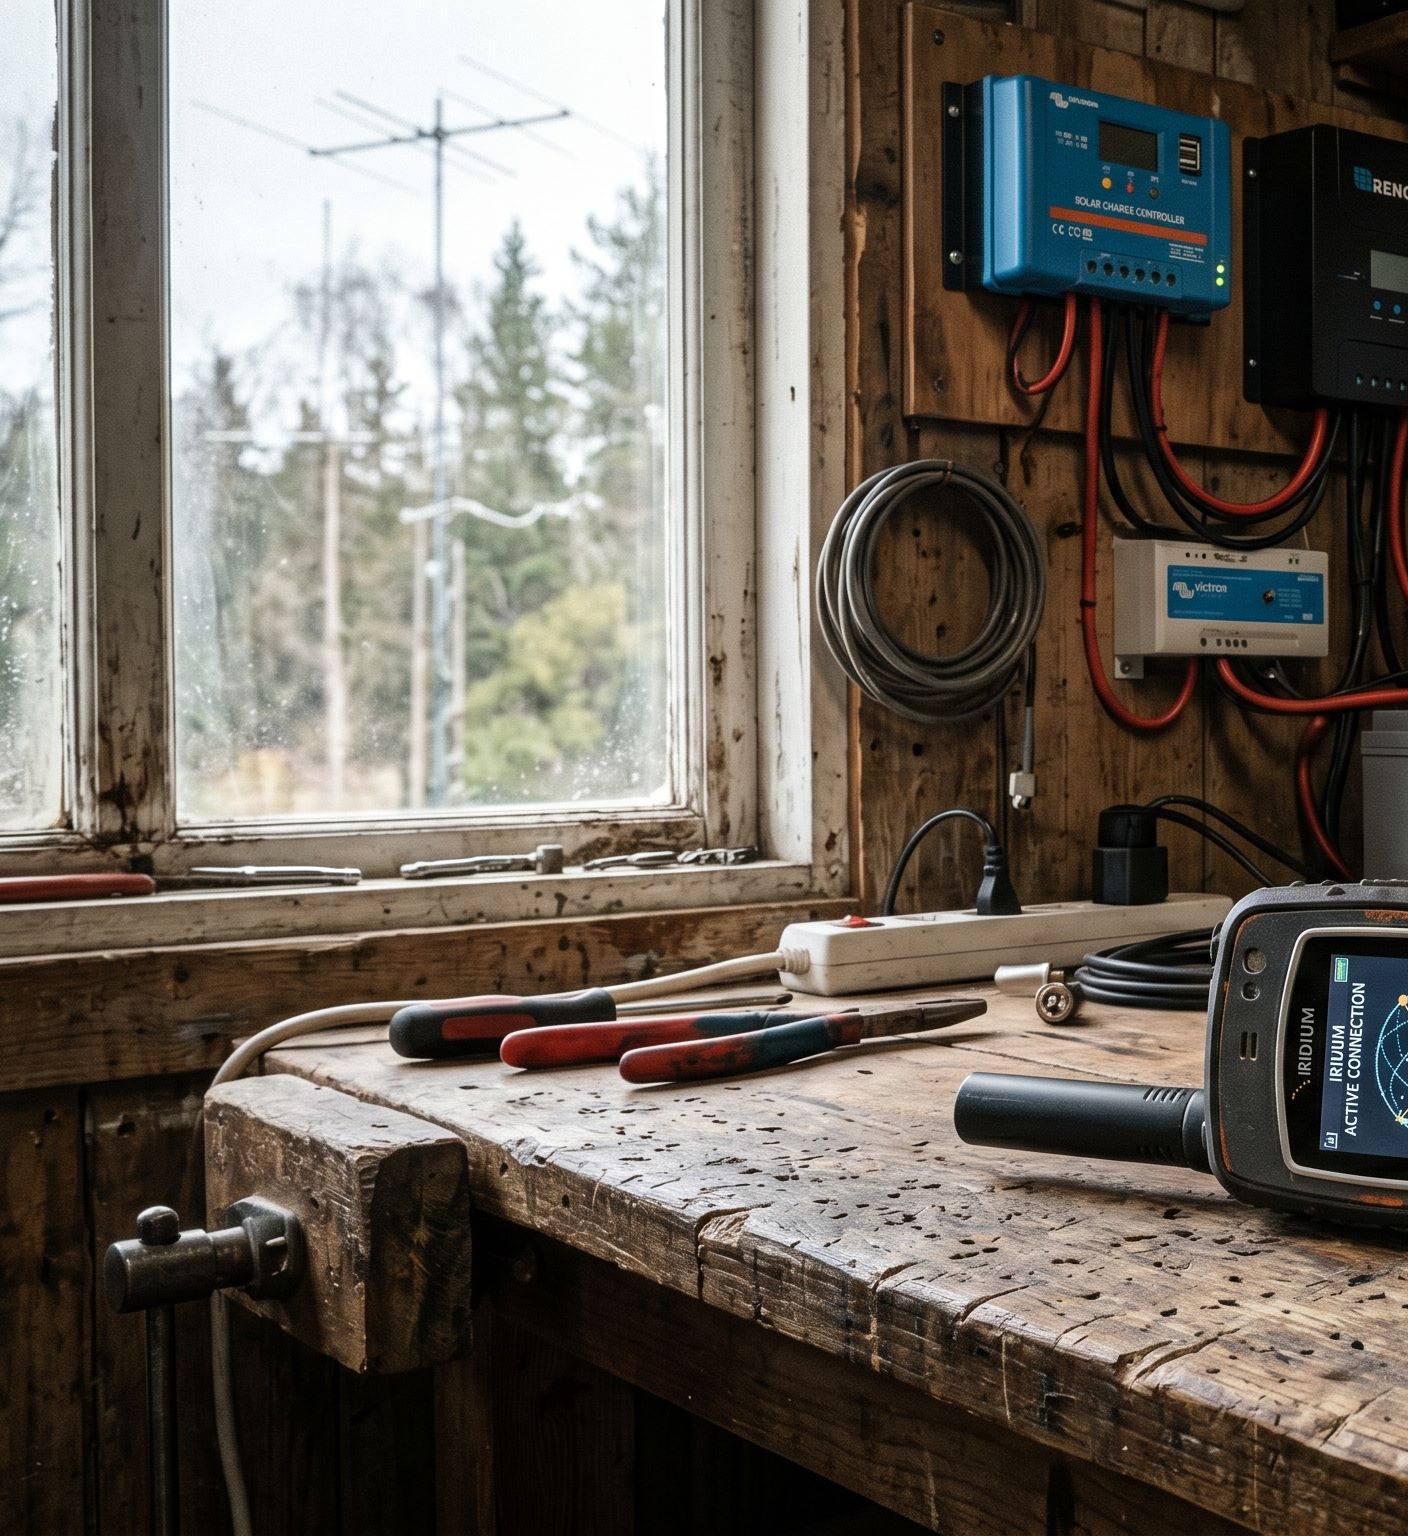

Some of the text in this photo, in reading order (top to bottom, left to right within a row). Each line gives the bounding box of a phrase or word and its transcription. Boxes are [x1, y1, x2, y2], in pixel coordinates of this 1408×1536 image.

[1075, 195, 1101, 209] SOLAR
[1195, 581, 1228, 593] victron
[1297, 1007, 1315, 1077] IRIDIUM
[1345, 983, 1366, 1136] ACTIVE CONNECTION
